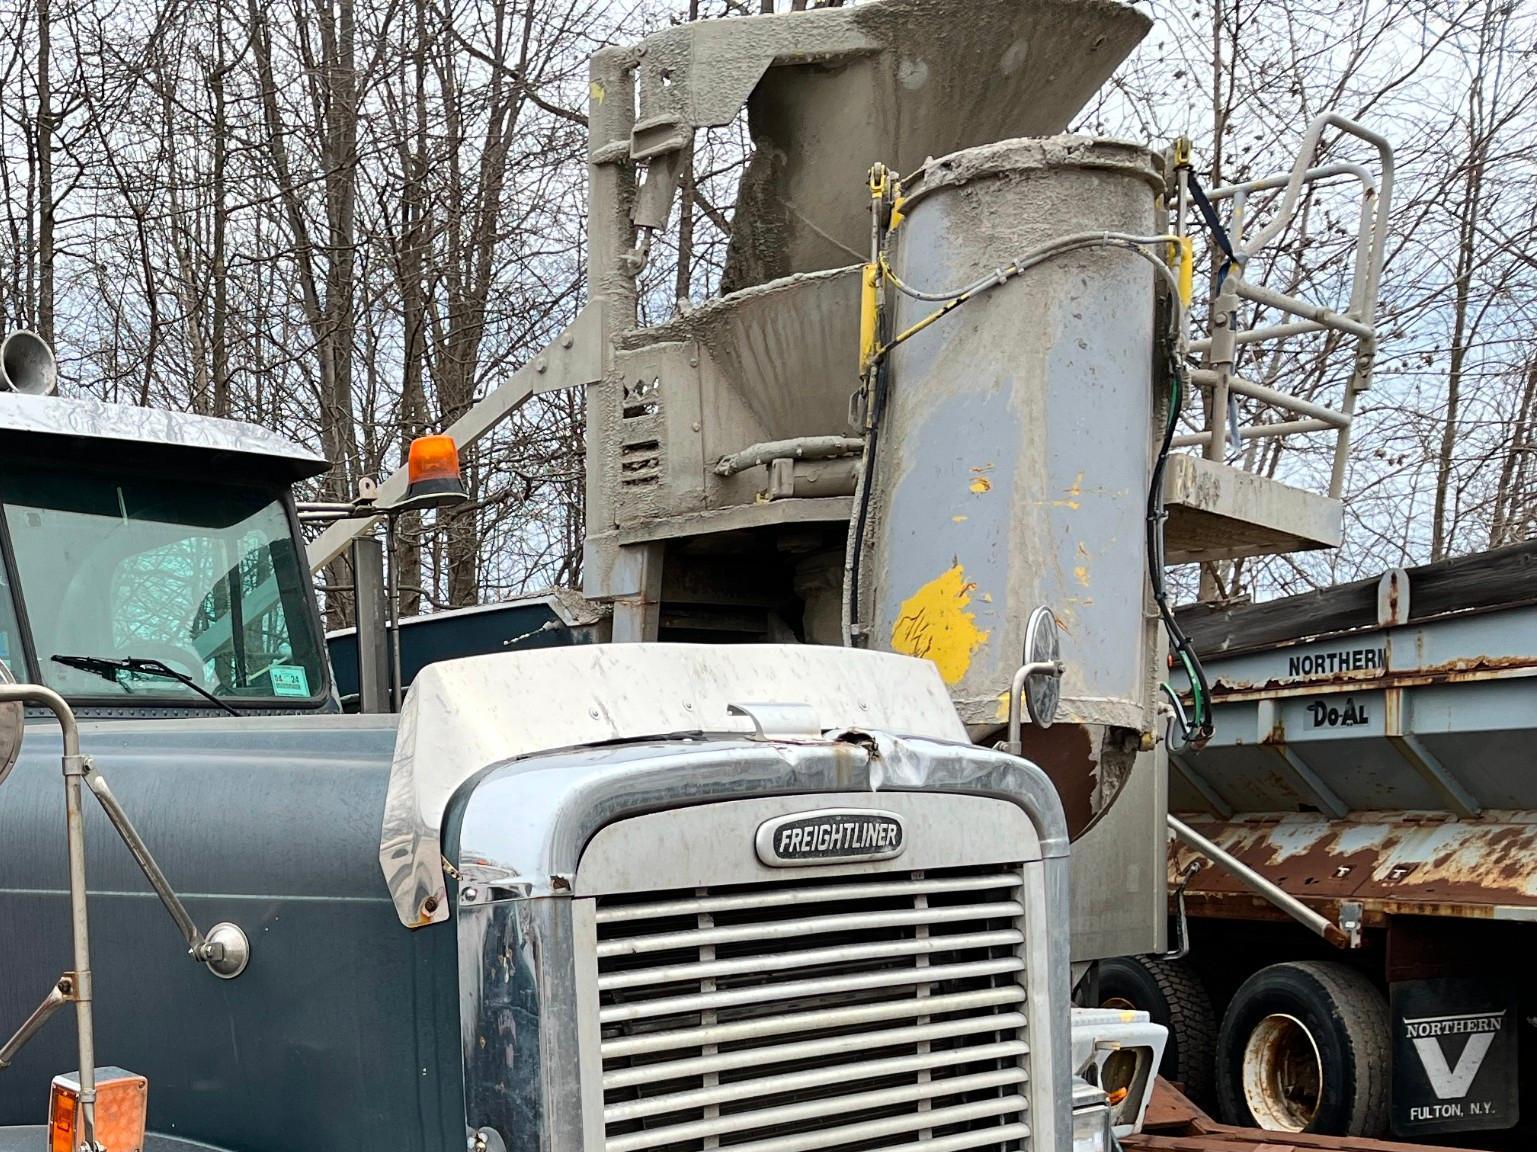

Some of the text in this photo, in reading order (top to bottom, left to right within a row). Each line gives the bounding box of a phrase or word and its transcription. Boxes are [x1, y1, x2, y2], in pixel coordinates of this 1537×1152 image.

[1288, 648, 1387, 677] NORTHERN
[779, 822, 898, 853] FREIGHTLINER
[1405, 1017, 1503, 1038] NORTHERN
[1410, 1101, 1496, 1121] FULTON, N.Y.
